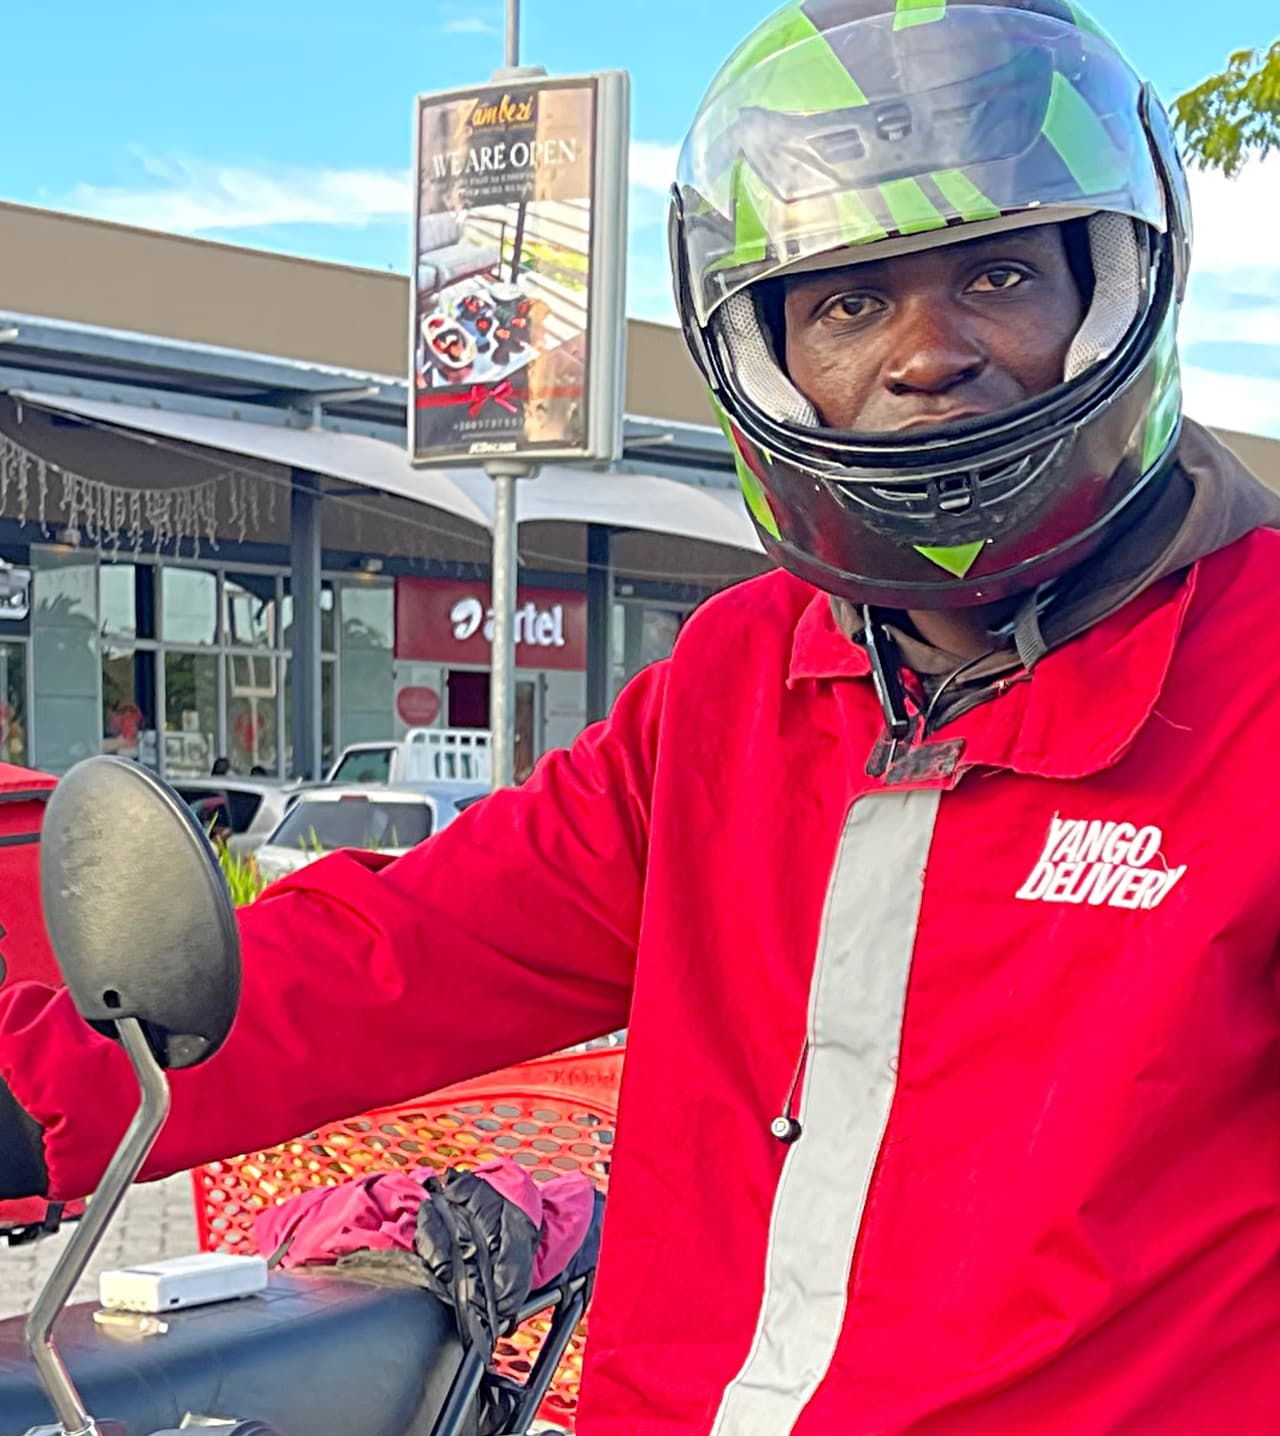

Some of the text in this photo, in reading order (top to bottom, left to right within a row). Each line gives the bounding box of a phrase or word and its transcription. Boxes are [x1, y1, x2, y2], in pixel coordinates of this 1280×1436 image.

[432, 136, 577, 178] WE ARE OPEN
[483, 602, 564, 646] artel
[1040, 812, 1162, 867] YANGO
[1015, 861, 1187, 909] DELIVERY
